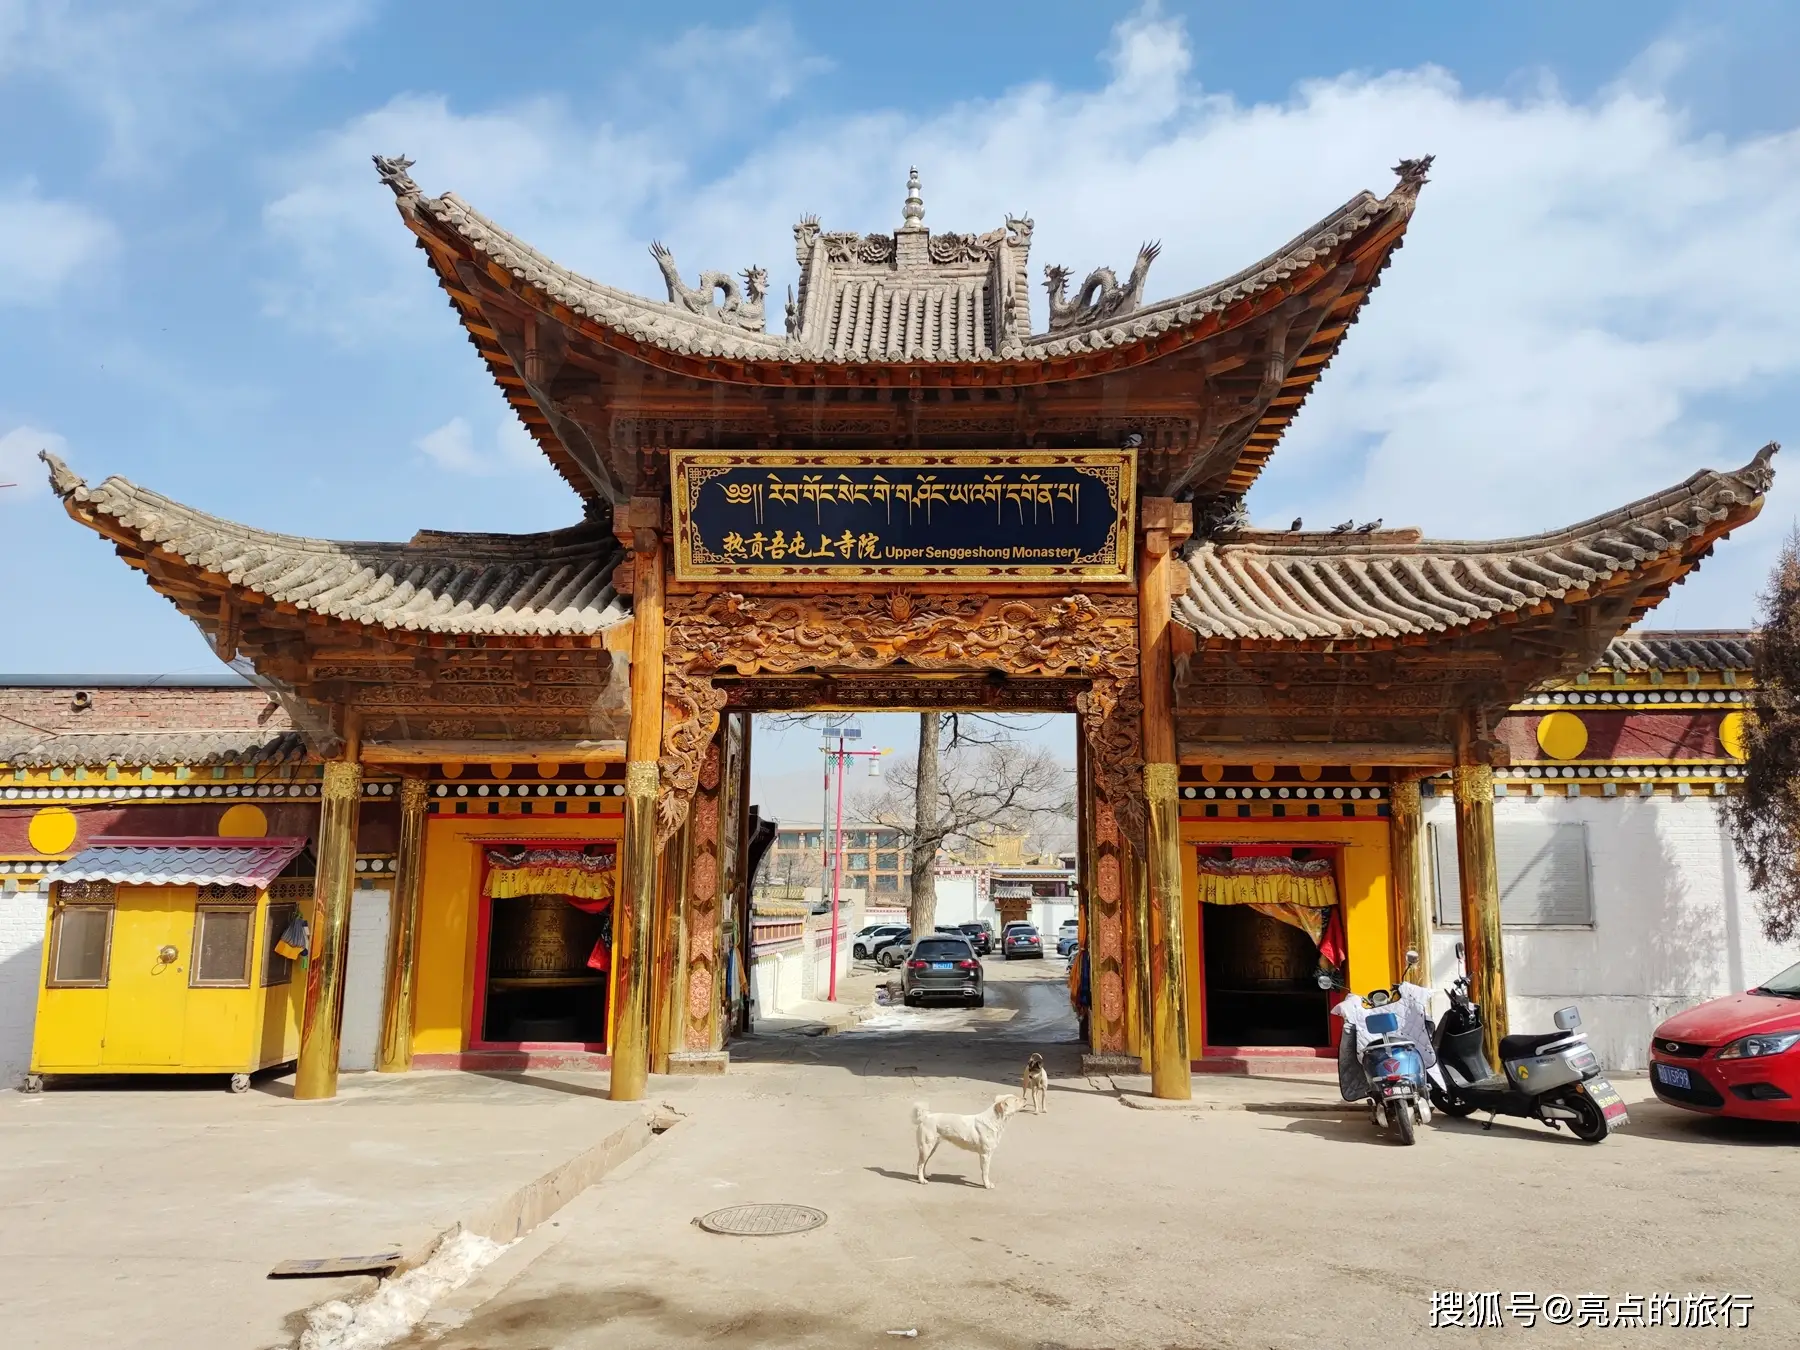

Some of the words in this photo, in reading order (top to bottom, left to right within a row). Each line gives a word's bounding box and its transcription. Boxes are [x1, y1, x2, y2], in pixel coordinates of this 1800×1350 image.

[722, 530, 882, 560] 热贡吾屯上寺院
[885, 546, 924, 559] Upper
[925, 546, 1010, 560] Senggeshong
[1012, 546, 1081, 560] Monastery
